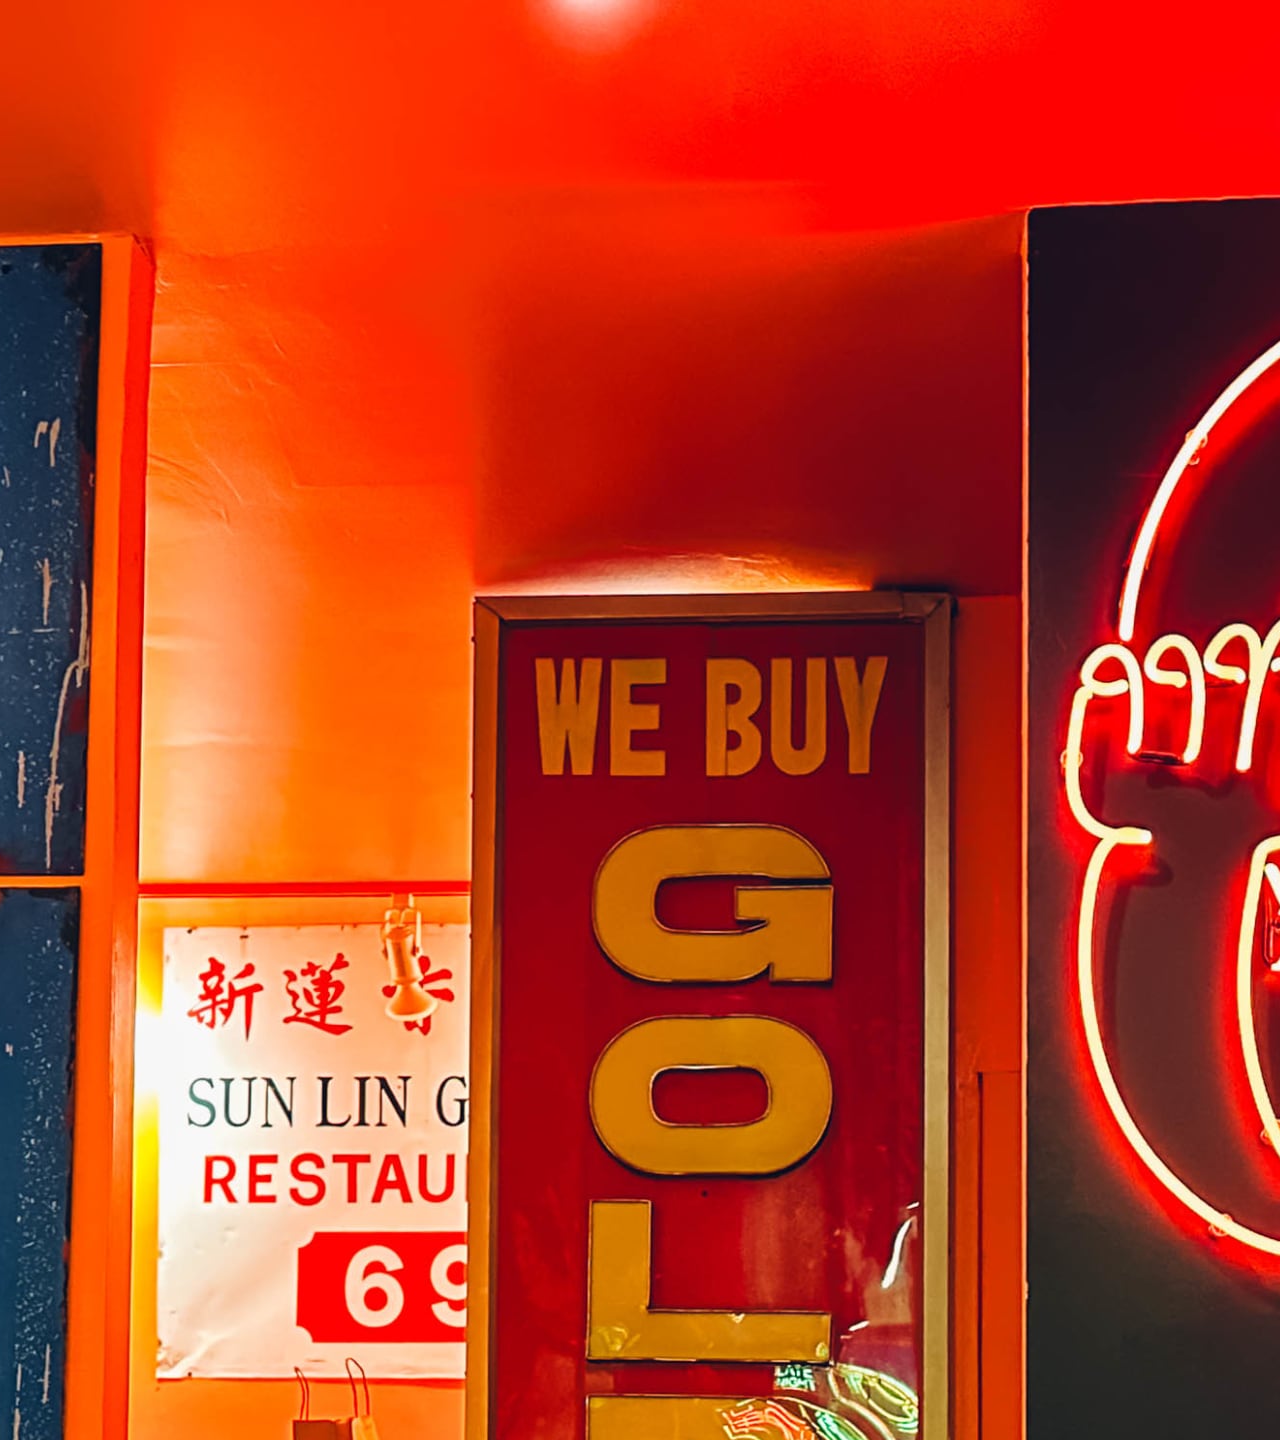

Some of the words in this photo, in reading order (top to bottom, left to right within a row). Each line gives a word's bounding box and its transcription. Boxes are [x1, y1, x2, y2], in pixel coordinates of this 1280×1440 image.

[534, 657, 668, 777] WE
[705, 655, 888, 777] BUY
[186, 1074, 297, 1129] SUN
[314, 1074, 413, 1128] LIN
[202, 1152, 469, 1207] RESTAU
